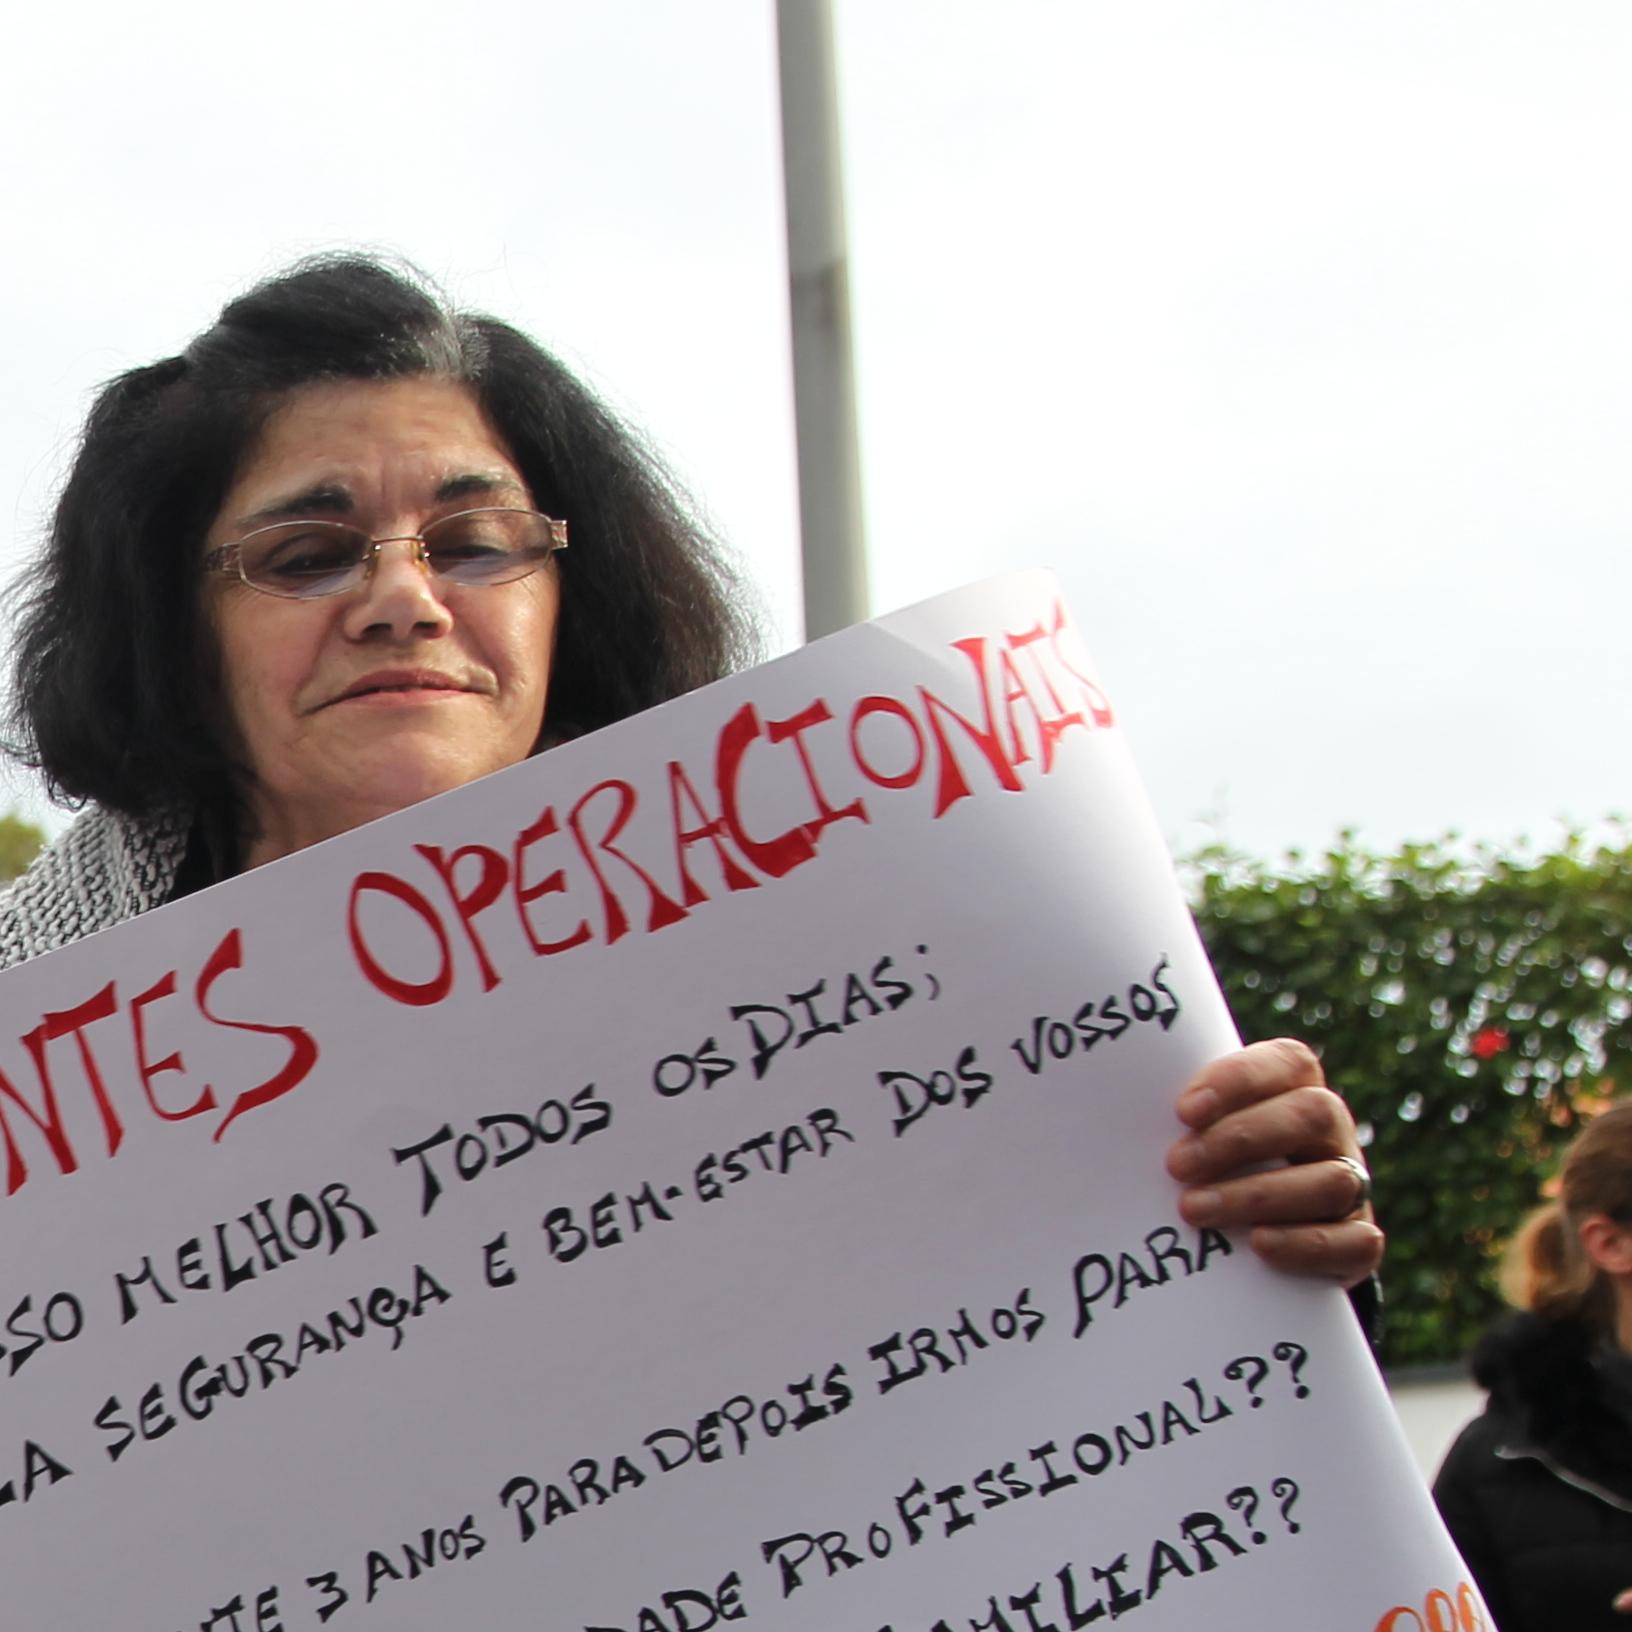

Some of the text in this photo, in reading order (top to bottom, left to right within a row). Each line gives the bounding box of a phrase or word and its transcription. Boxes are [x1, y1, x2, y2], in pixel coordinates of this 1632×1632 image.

[347, 597, 1114, 1007] OPERACIONAIS
[93, 1265, 451, 1460] SEGURANÇA
[484, 1234, 517, 1289] E
[542, 1107, 853, 1265] BEM-ESTAR
[878, 1046, 993, 1136] DOS
[1011, 952, 1183, 1075] VOSSOS
[115, 1180, 380, 1323] MELHOR
[391, 1083, 613, 1216] TODOS
[306, 1572, 349, 1624] 3
[365, 1515, 486, 1604] ANOS
[868, 1288, 1046, 1395] IRMOS
[1072, 1224, 1234, 1340] PARA
[761, 1340, 1312, 1600] PROFISSIONAL??
